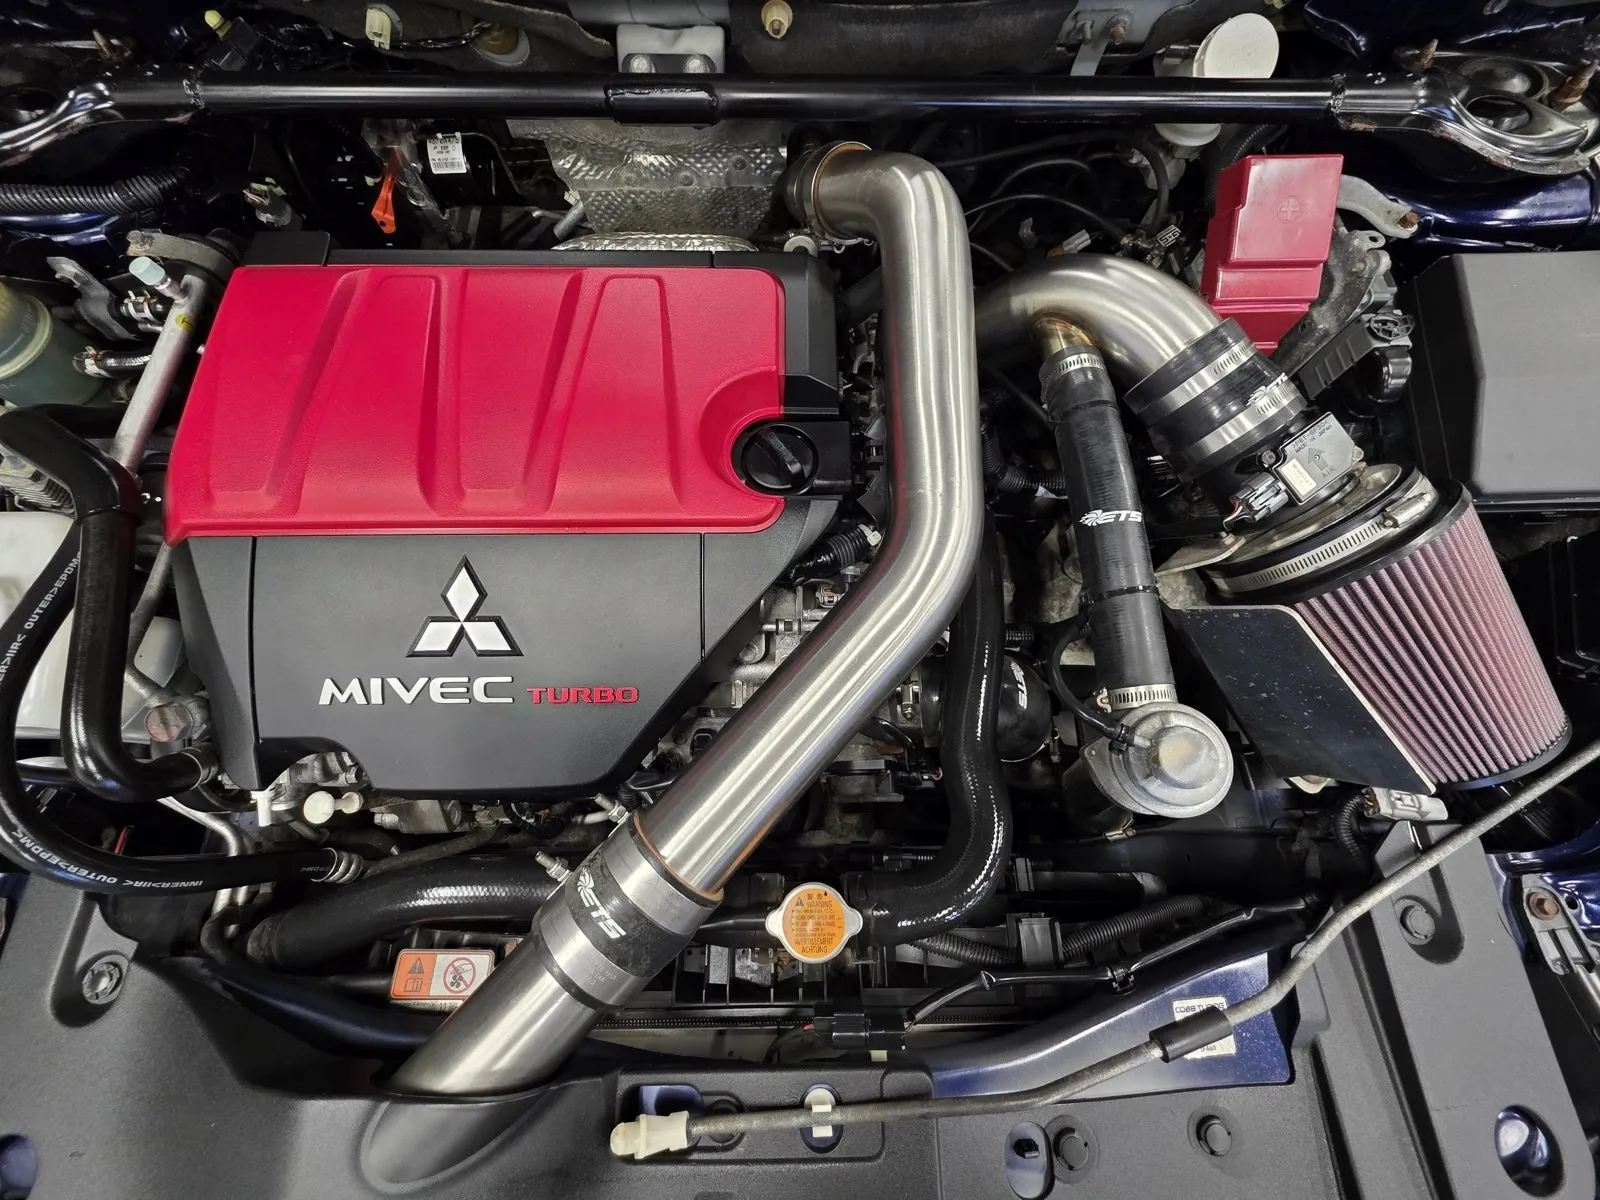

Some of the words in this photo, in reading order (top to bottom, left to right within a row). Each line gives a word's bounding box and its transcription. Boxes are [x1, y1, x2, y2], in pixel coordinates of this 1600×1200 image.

[1318, 424, 1333, 437] JAPAN
[1321, 465, 1336, 478] AIR
[1097, 510, 1143, 525] ETS
[318, 676, 515, 706] MIVEC
[525, 685, 640, 704] TURBO
[806, 900, 832, 908] WARNING
[578, 888, 627, 939] ETS
[794, 937, 834, 945] AVERTISSEMENT
[801, 945, 828, 954] ACHTUNG
